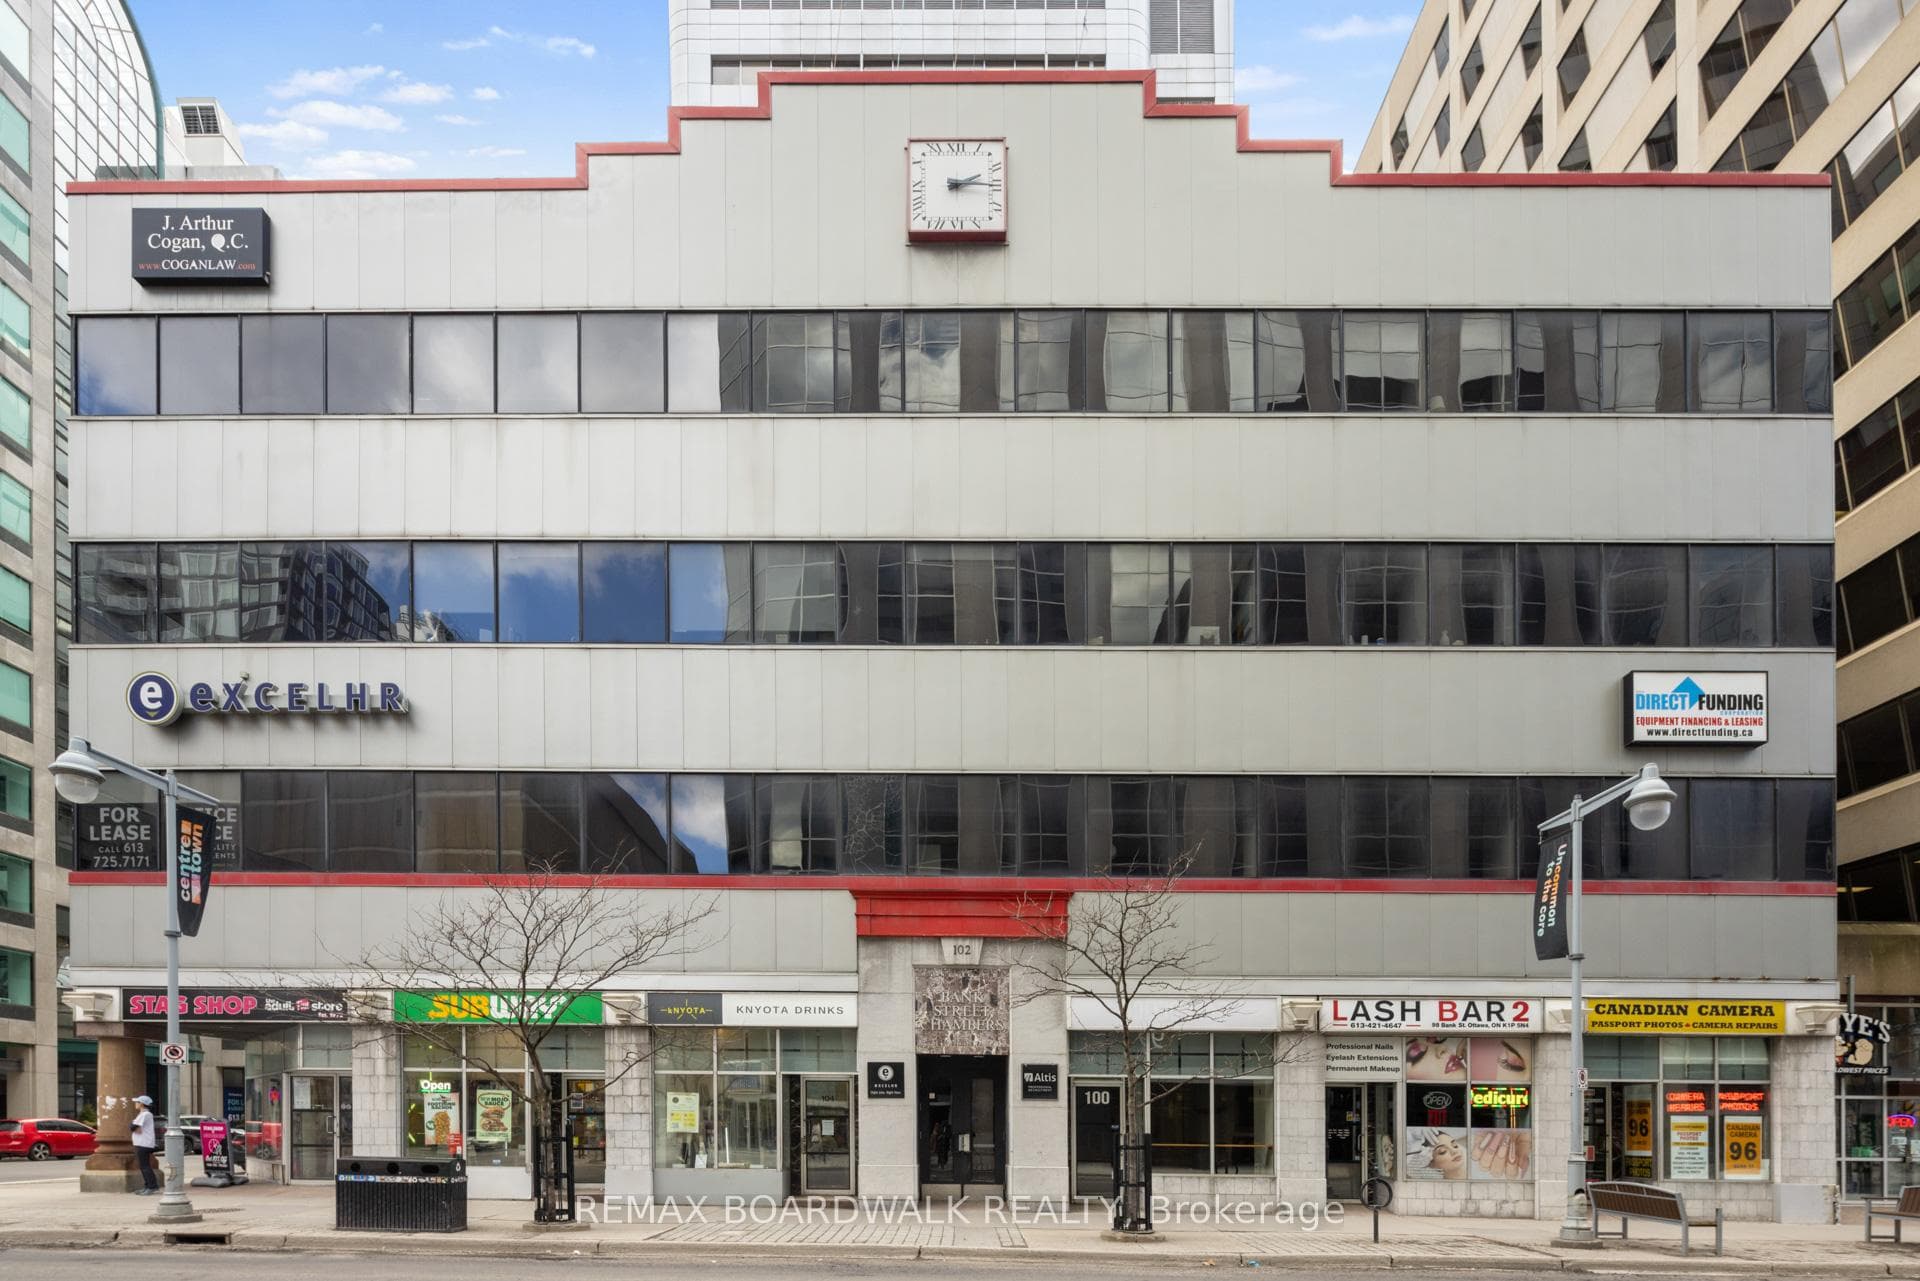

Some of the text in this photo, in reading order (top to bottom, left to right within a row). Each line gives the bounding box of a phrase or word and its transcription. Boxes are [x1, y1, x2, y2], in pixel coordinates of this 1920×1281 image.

[162, 215, 234, 231] J. Arthur
[148, 233, 249, 252] Cogan, Q.C.
[1635, 693, 1763, 711] DIRECT FUNDING
[1636, 717, 1763, 726] EQUIPMENT FINANCING & LEASING
[1647, 727, 1753, 737] www.directfunding.ca
[100, 807, 140, 823] FOR
[89, 825, 151, 841] LEASE
[98, 842, 144, 854] CALL 613
[191, 824, 203, 873] town
[93, 856, 150, 868] 725.7171
[179, 835, 192, 902] centre
[1547, 843, 1568, 927] Uncommon
[1537, 860, 1555, 937] to the core
[953, 944, 971, 956] 102
[941, 991, 985, 1002] BANK
[129, 995, 257, 1015] STAG SHOP
[736, 1005, 844, 1015] KNYOTA DRINKS
[934, 1005, 990, 1016] STREET
[1333, 999, 1420, 1021] LASH
[1594, 1004, 1775, 1016] CANADIAN CAMERA
[1591, 1020, 1778, 1029] PASSPORT PHOTOS CAMERA REPAIRS
[1326, 1054, 1355, 1062] Eyelash
[1369, 1065, 1401, 1073] Makeup
[1034, 1072, 1057, 1082] Altis
[420, 1079, 451, 1091] Open
[1084, 1090, 1110, 1105] 100
[1629, 1118, 1649, 1137] 96
[1729, 1141, 1757, 1161] 96
